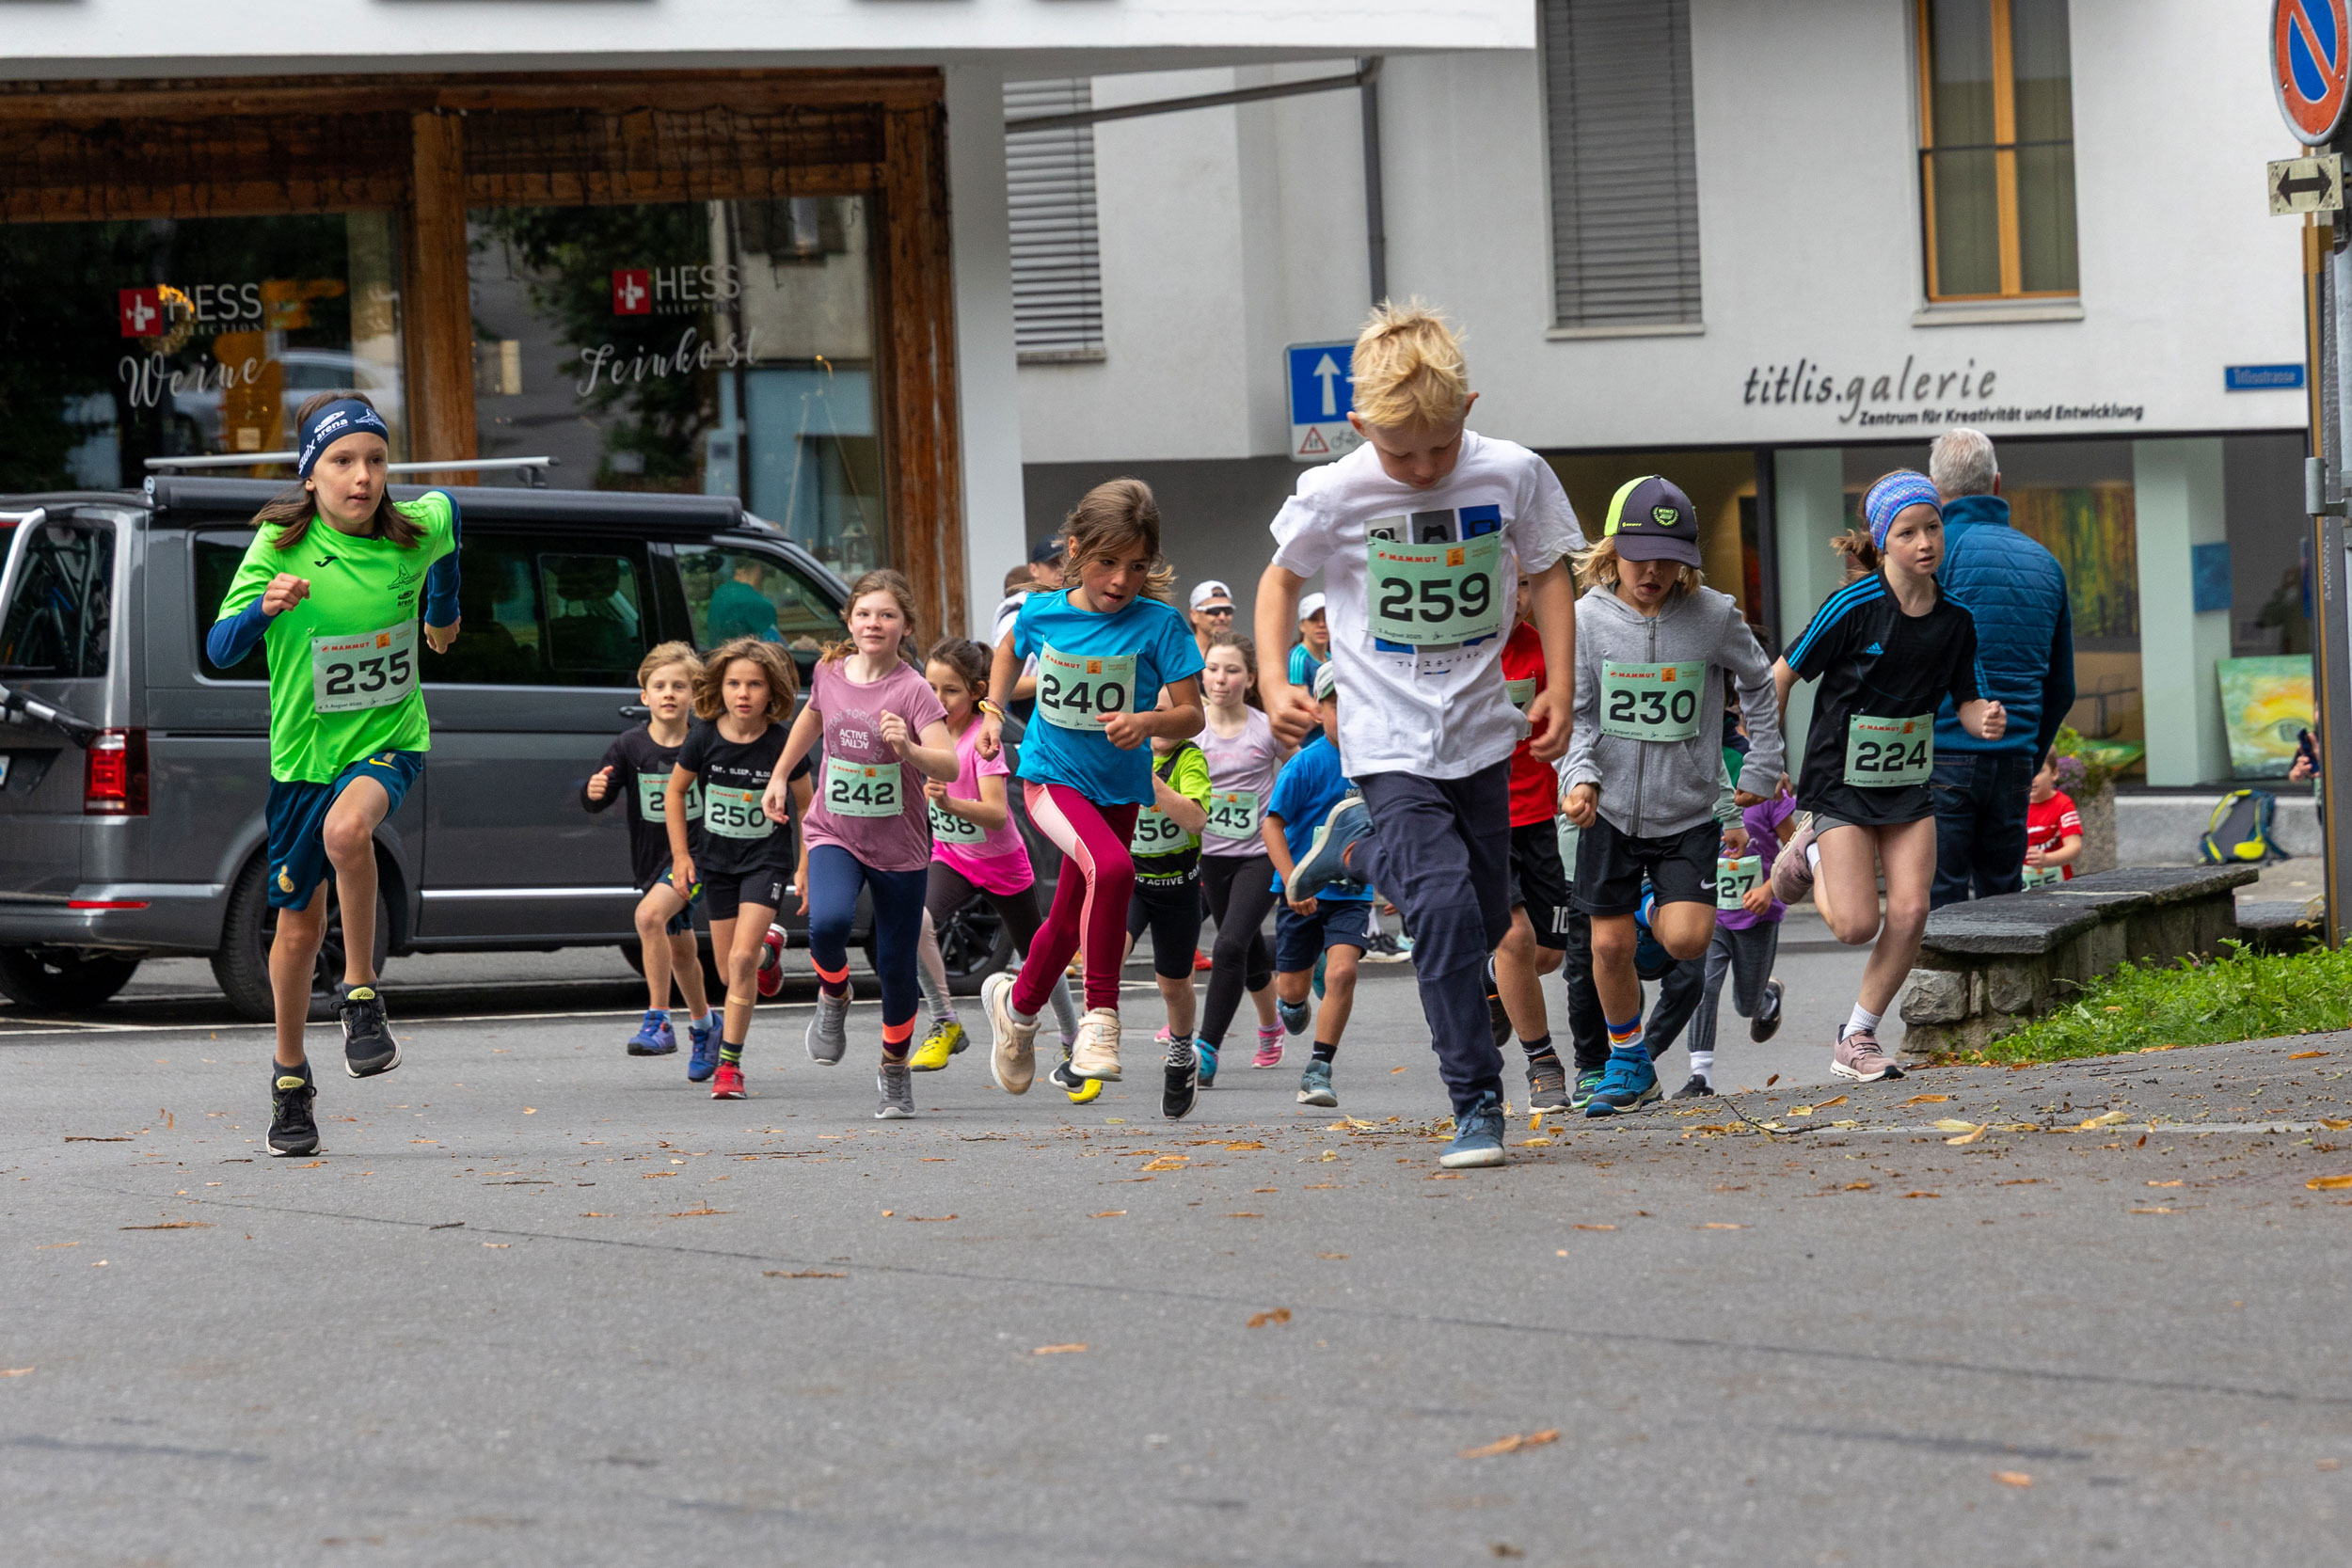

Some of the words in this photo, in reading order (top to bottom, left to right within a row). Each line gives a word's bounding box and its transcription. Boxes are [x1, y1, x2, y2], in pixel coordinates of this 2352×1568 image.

[656, 264, 741, 301] HESS
[167, 283, 262, 322] HESS
[119, 351, 267, 407] Weine
[1744, 355, 1996, 423] titlis.galerie
[1859, 410, 1918, 425] Zentrum
[1921, 408, 1942, 424] für
[1945, 406, 2022, 423] Kreativität
[2025, 404, 2053, 420] und
[2056, 403, 2144, 421] Entwicklung
[316, 419, 349, 442] arena
[1389, 554, 1438, 563] MAMMUT
[1380, 572, 1490, 623] 259
[331, 641, 370, 651] MAMMUT
[326, 648, 410, 695] 235
[1050, 657, 1080, 669] MAMMUT
[1041, 673, 1124, 714] 240
[1610, 689, 1696, 724] 230
[839, 728, 868, 741] ACTIVE
[1855, 739, 1927, 771] 224
[649, 789, 697, 811] 21
[832, 779, 895, 805] 242
[710, 802, 767, 828] 250
[930, 807, 976, 835] 238
[1207, 806, 1250, 829] 43
[1133, 816, 1180, 842] 56
[1147, 876, 1184, 886] ACTIVE
[1721, 875, 1755, 898] 27
[1552, 906, 1568, 934] 10
